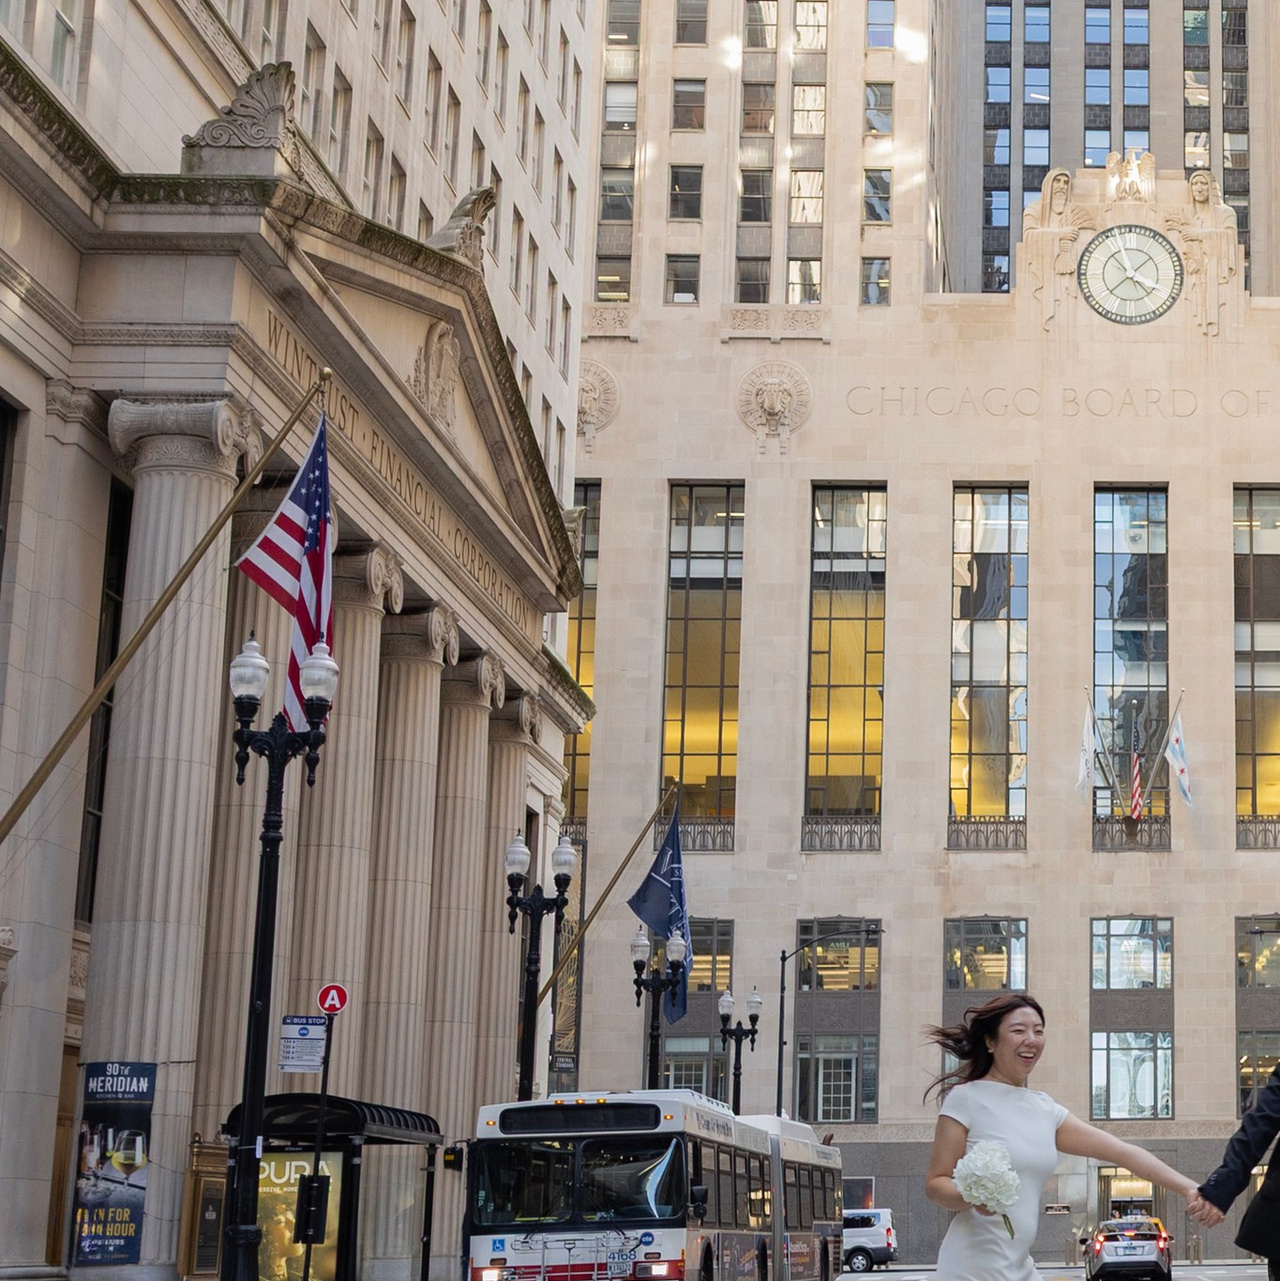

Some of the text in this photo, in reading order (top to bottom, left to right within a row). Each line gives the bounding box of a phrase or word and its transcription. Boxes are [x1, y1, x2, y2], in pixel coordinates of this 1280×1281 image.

[846, 385, 1042, 417] CHICAGO
[1061, 387, 1198, 419] BOARD
[1220, 389, 1273, 418] OF
[370, 428, 444, 541] FINANCIAL
[454, 528, 531, 633] CORPORATION
[324, 990, 341, 1008] A
[88, 1077, 148, 1092] MERIDIAN
[109, 1208, 131, 1221] FOR
[106, 1223, 136, 1236] HOUR
[608, 1250, 637, 1261] 4168
